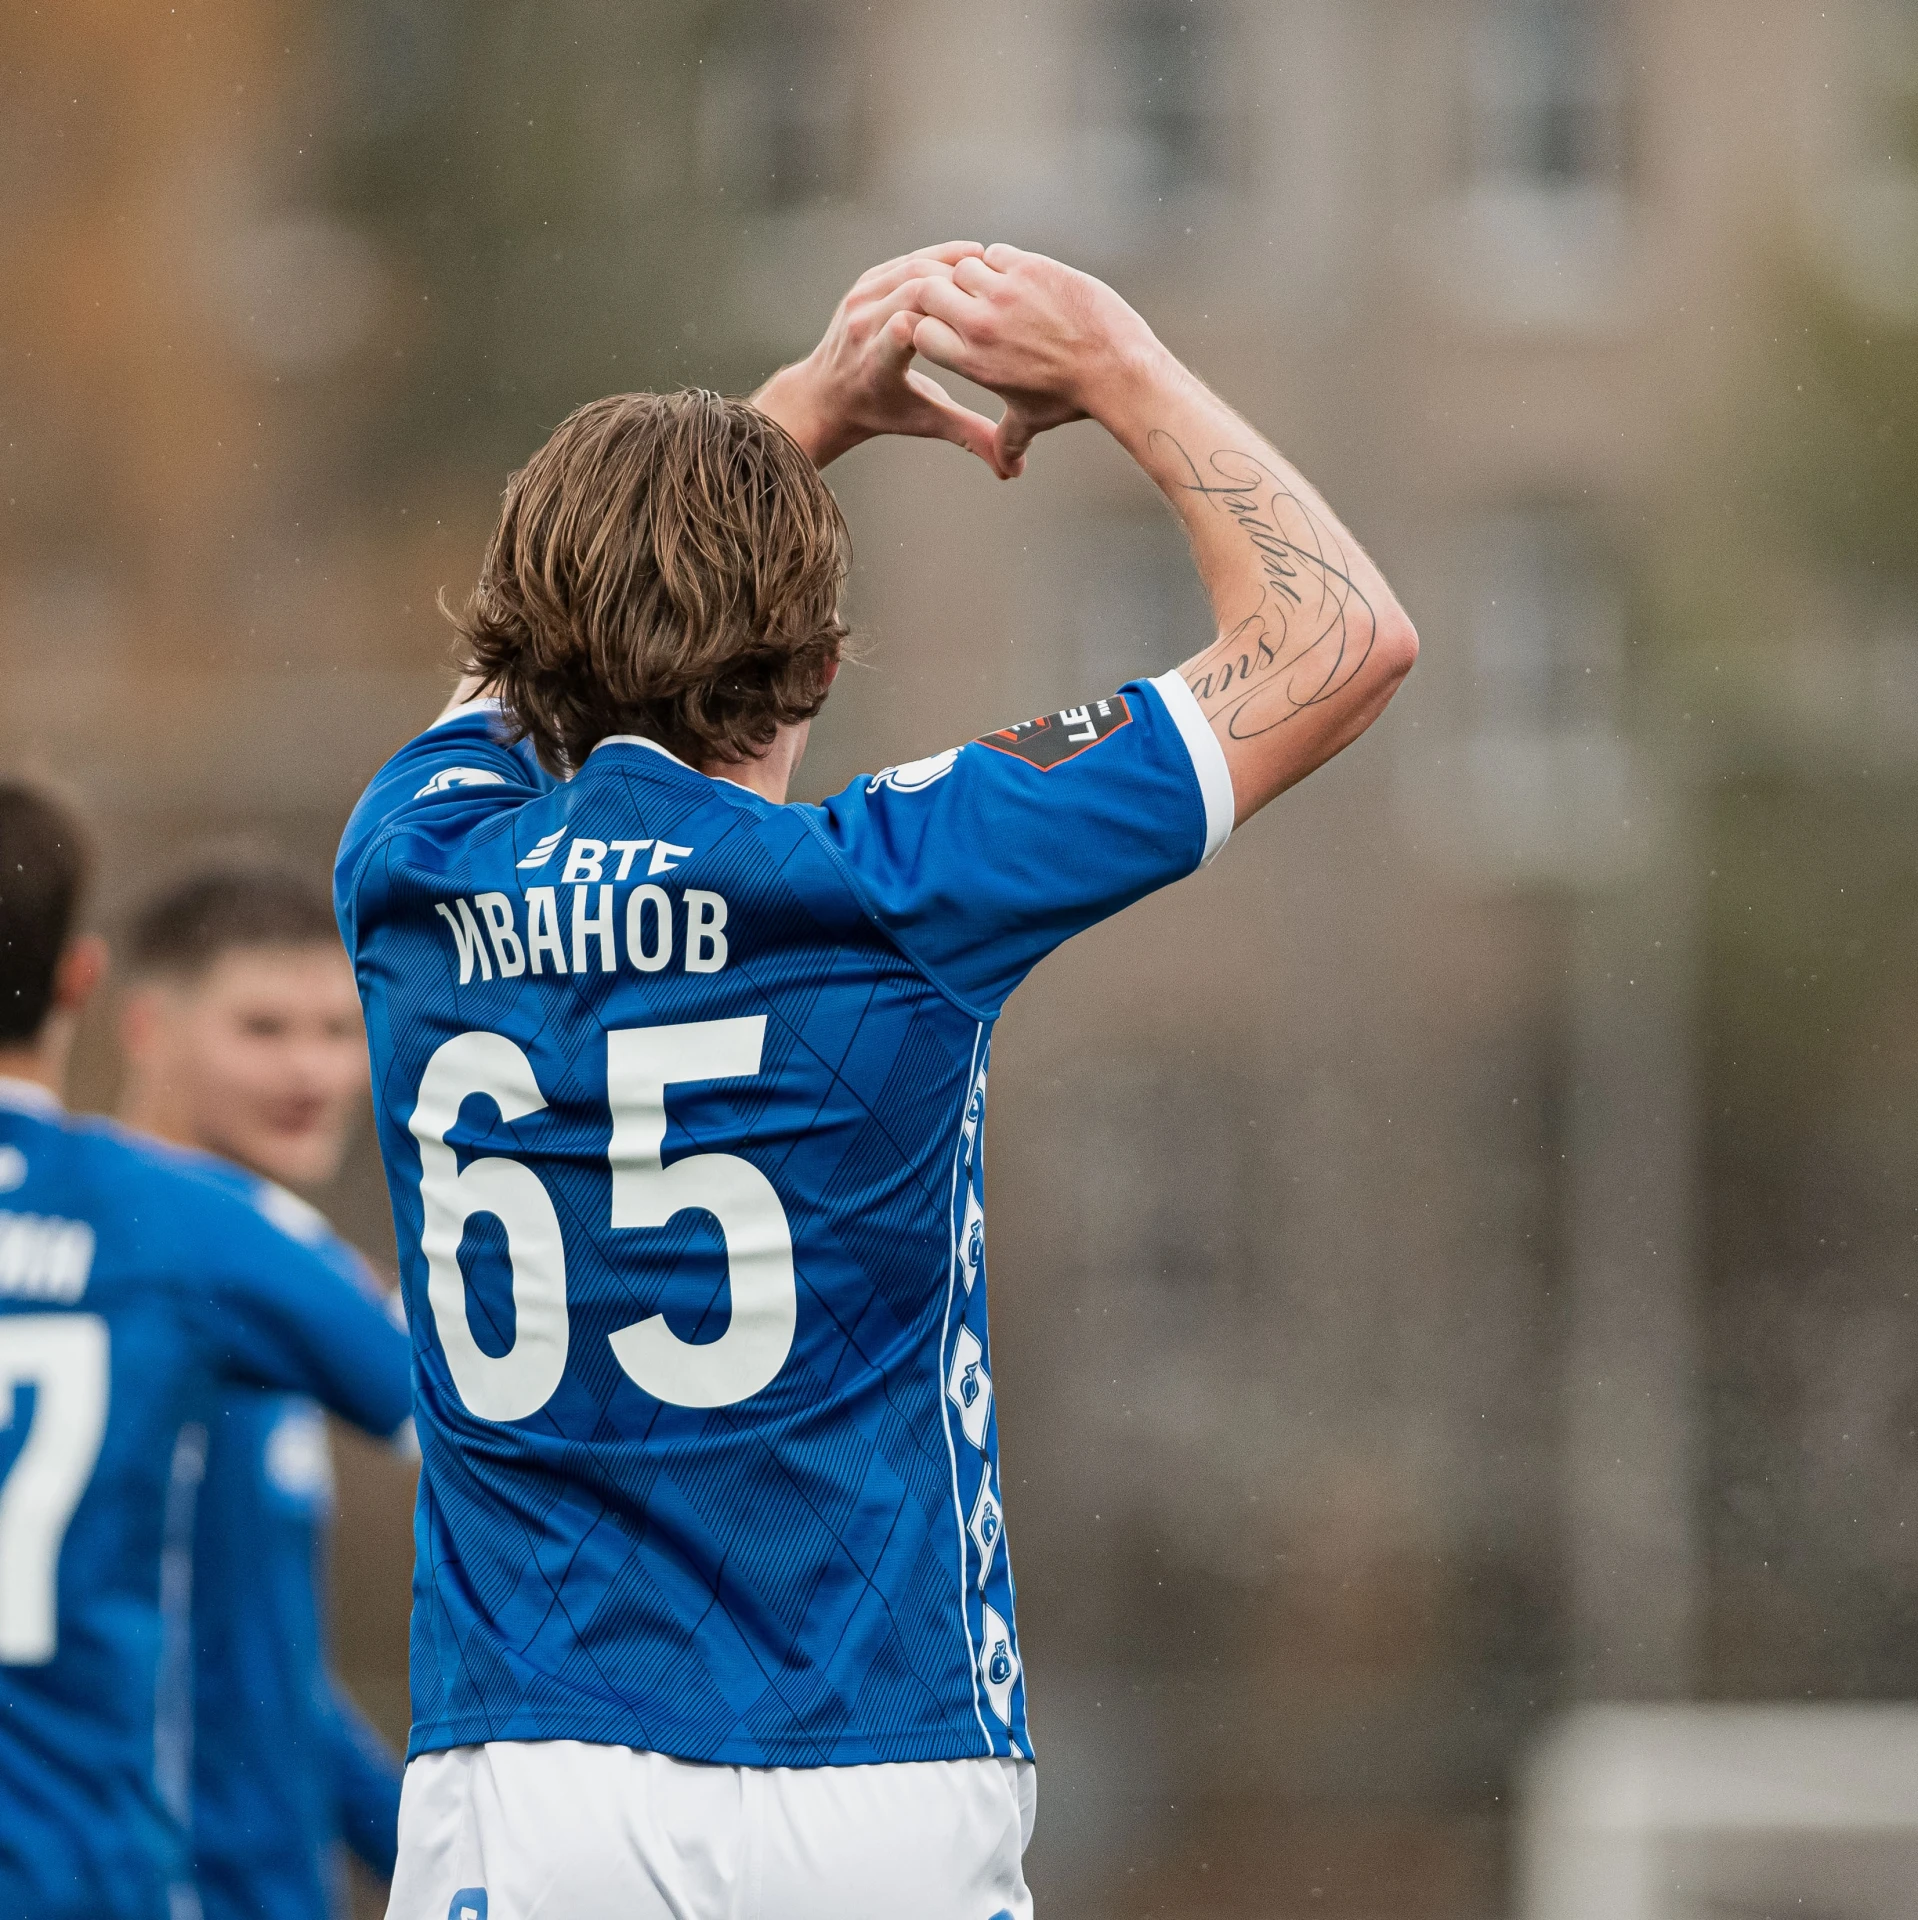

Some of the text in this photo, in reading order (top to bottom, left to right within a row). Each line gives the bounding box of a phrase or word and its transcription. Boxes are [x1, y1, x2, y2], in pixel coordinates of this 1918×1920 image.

[1189, 622, 1281, 701] ans
[1059, 705, 1098, 742] LE
[435, 884, 728, 985] ИВАНОВ
[408, 1014, 797, 1422] 65
